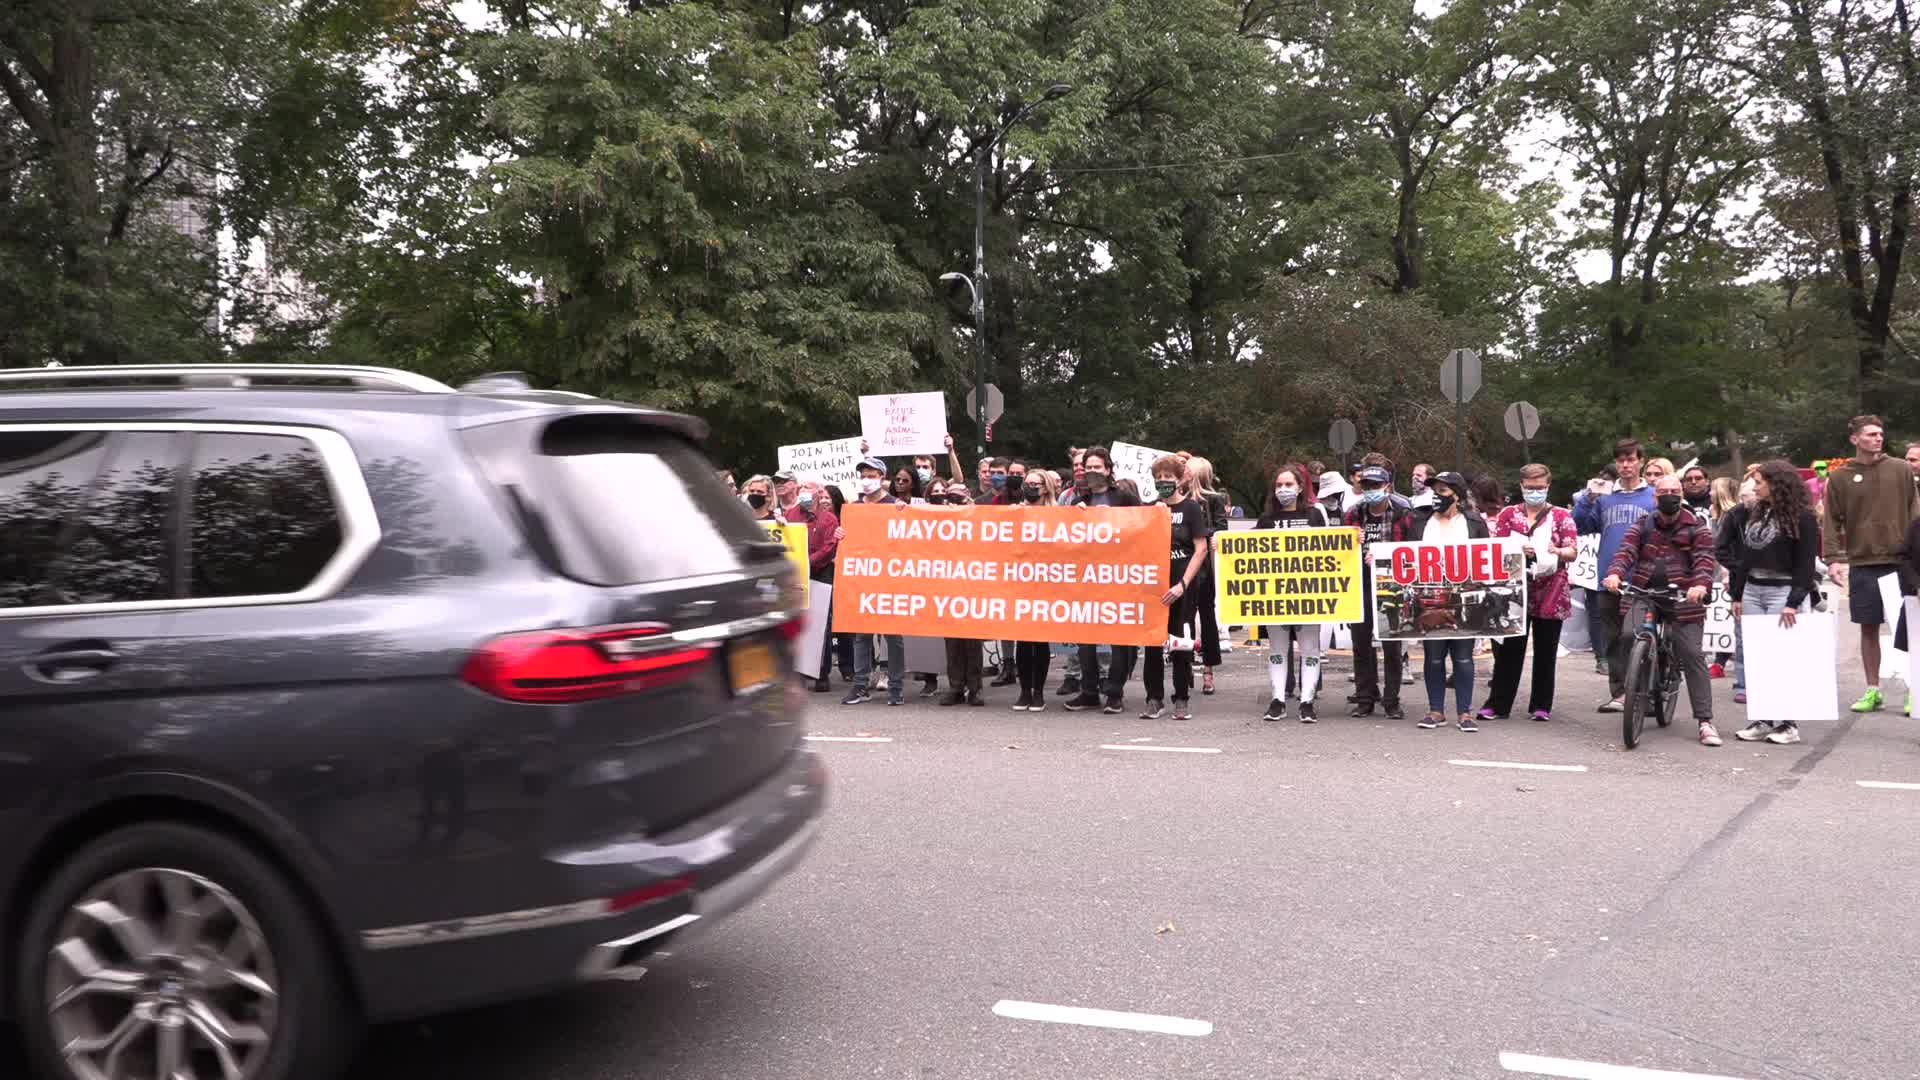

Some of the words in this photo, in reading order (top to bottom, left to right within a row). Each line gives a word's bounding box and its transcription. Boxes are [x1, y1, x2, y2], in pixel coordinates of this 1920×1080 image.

[791, 446, 823, 459] JOIN
[827, 441, 849, 454] THE
[1124, 445, 1158, 460] TEX
[790, 455, 853, 472] MOVEMENT
[887, 519, 973, 542] MAYOR
[981, 521, 1013, 542] DE
[1021, 522, 1121, 544] BLASIO:
[1221, 536, 1280, 555] HORSE
[1285, 534, 1353, 551] DRAWN
[842, 557, 882, 576] END
[887, 559, 997, 582] CARRIAGE
[1004, 562, 1077, 583] HORSE
[1083, 564, 1158, 585] ABUSE
[1234, 555, 1341, 575] CARRIAGES:
[1392, 543, 1510, 585] CRUEL
[1226, 578, 1269, 596] NOT
[1275, 577, 1351, 594] FAMILY
[859, 593, 926, 616] KEEP
[933, 596, 1006, 620] YOUR
[1014, 599, 1145, 625] PROMISE!
[1240, 598, 1338, 616] FRIENDLY
[1703, 632, 1732, 649] TO
